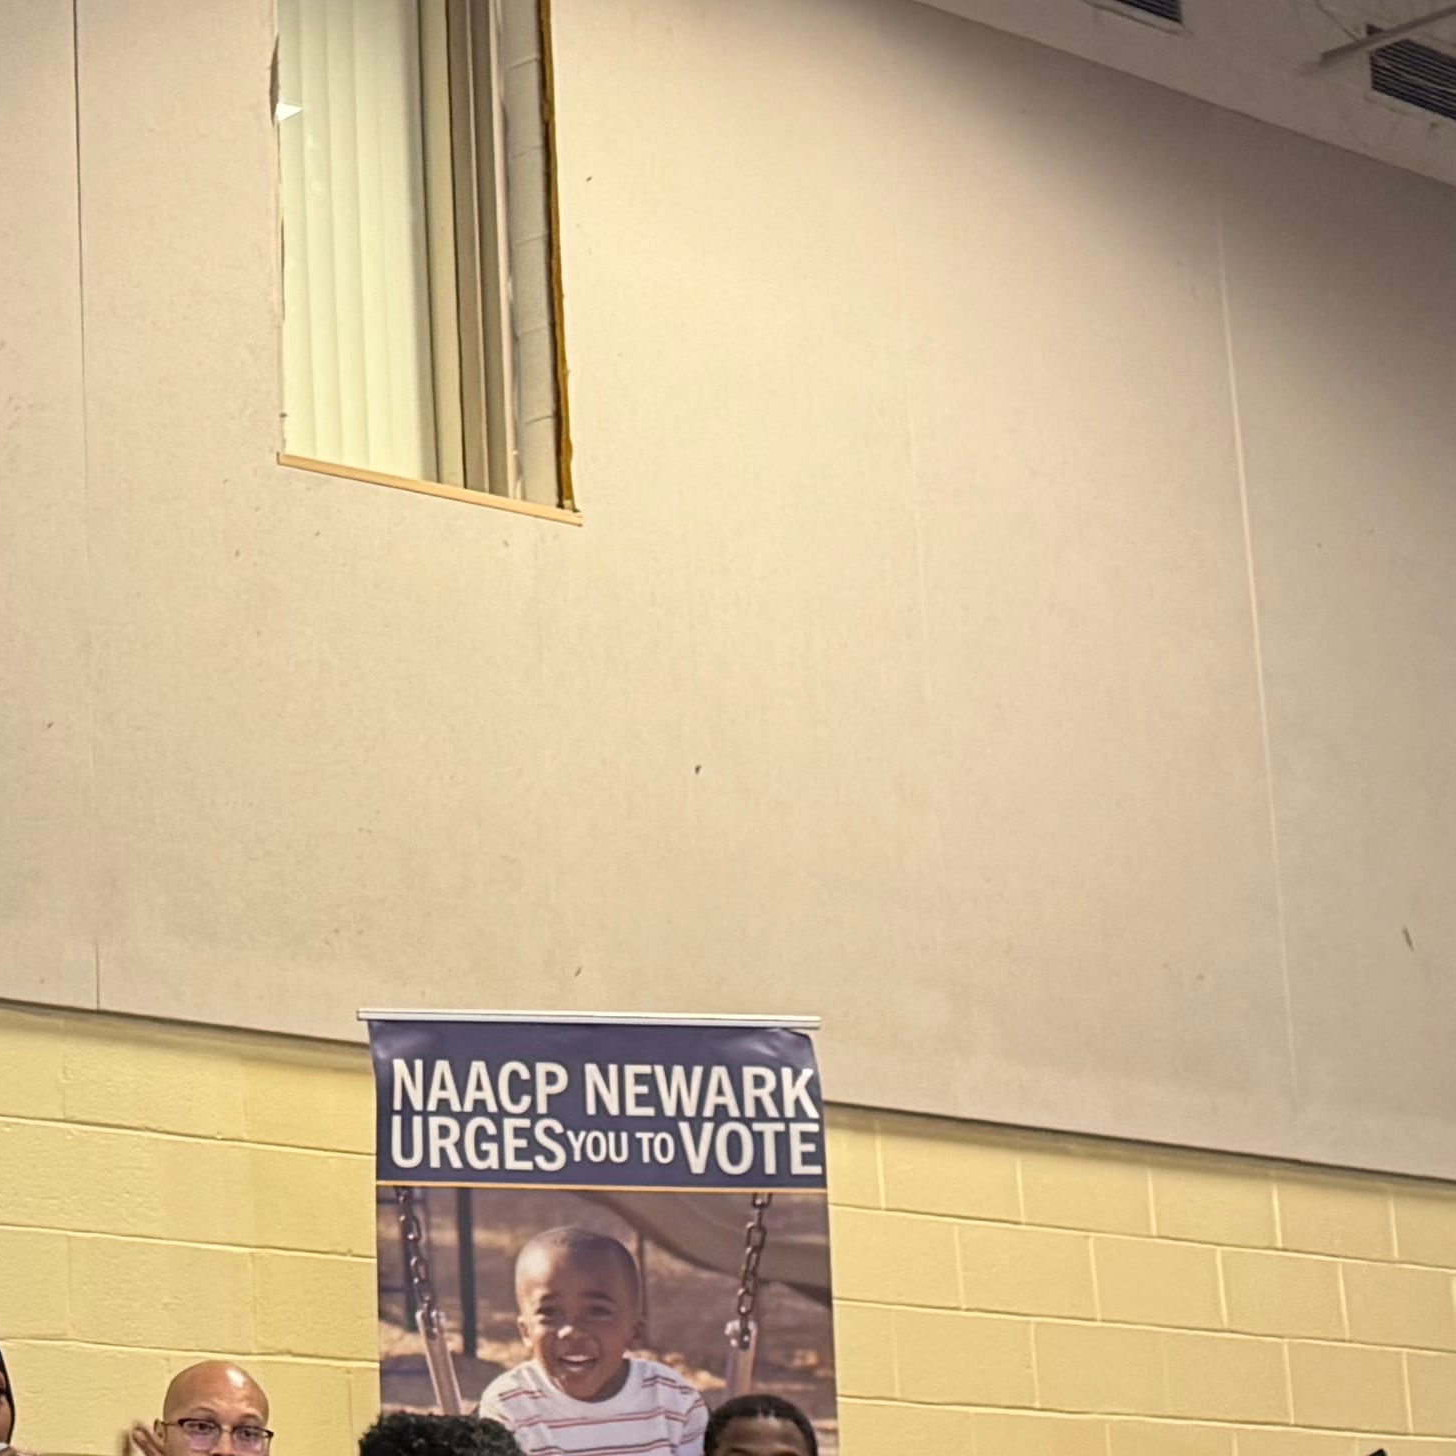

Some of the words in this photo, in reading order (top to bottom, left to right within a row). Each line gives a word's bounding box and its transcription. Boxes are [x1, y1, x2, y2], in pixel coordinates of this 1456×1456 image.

[392, 1058, 568, 1115] NAACP
[584, 1062, 820, 1119] NEWARK
[391, 1115, 567, 1172] URGES
[566, 1130, 628, 1164] YOU
[636, 1131, 675, 1165] TO
[678, 1121, 823, 1176] VOTE
